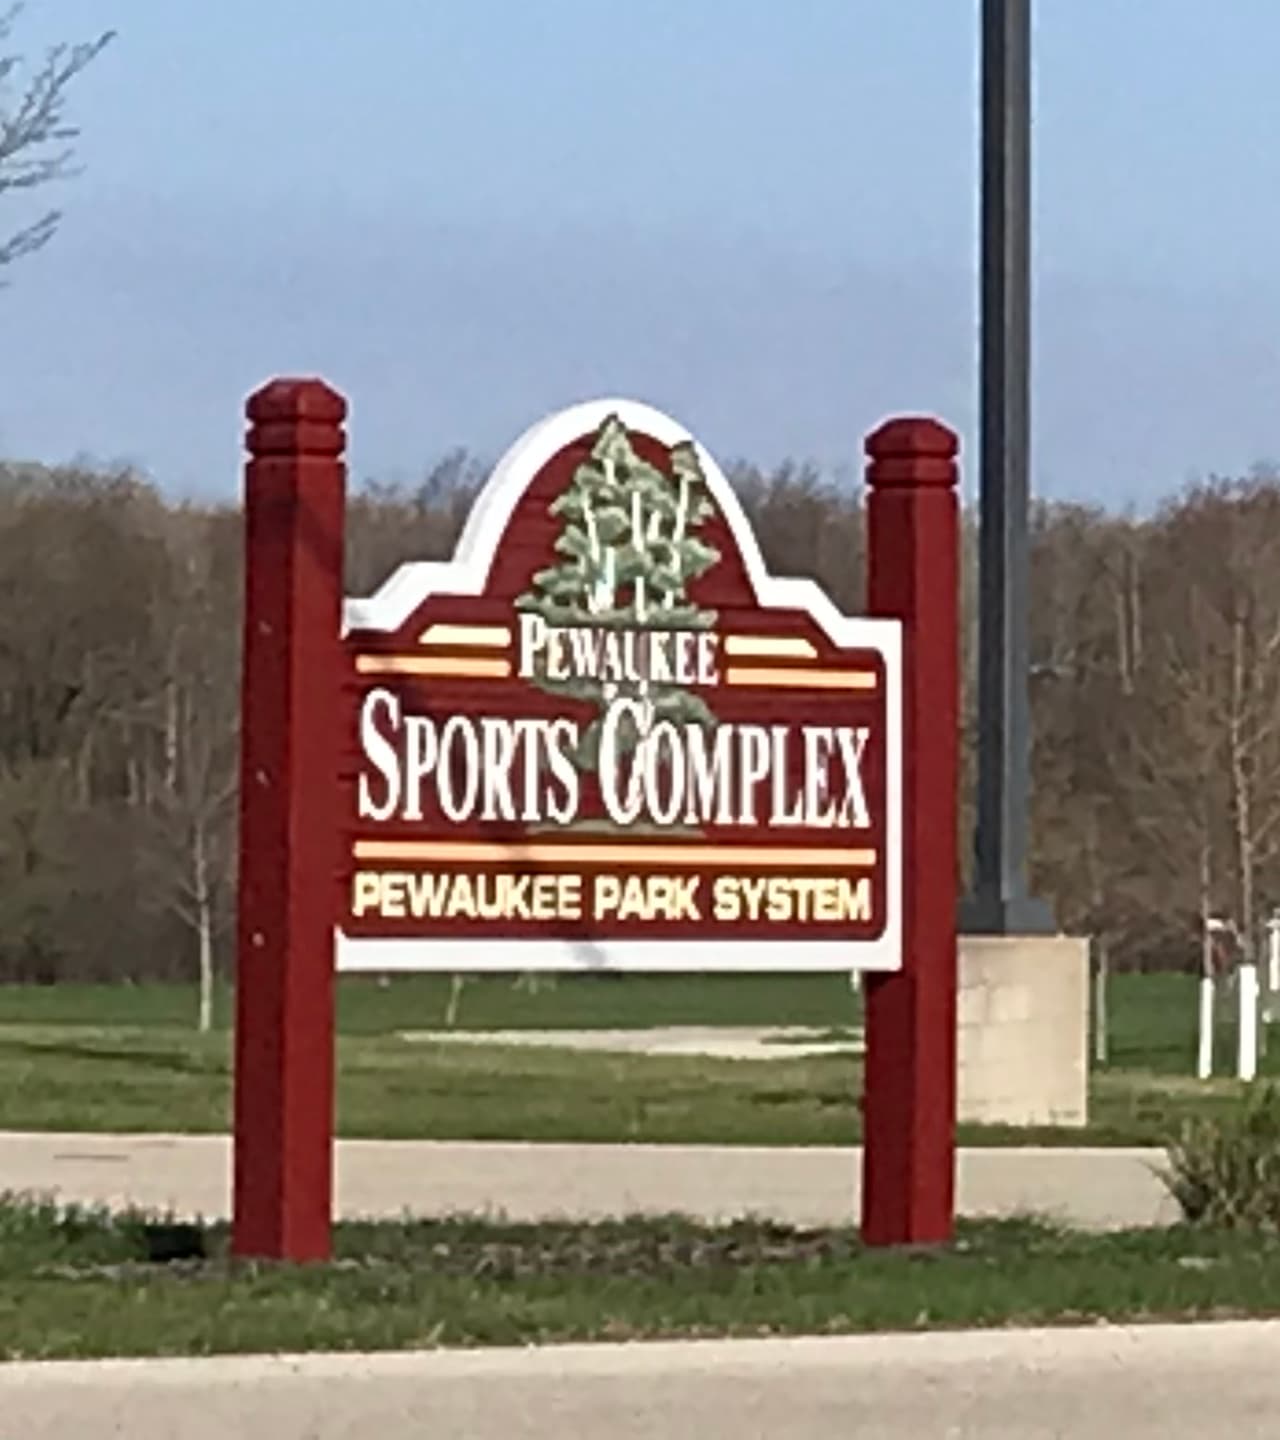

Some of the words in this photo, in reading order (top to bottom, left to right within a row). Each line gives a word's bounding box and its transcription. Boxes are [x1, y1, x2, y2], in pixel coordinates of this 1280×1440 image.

[518, 613, 719, 686] PEWAUKEE
[358, 689, 580, 825] SPORTS
[601, 697, 872, 829] COMPLEX
[353, 872, 582, 919] PEWAUKEE
[595, 875, 700, 921] PARK
[713, 878, 873, 922] SYSTEM
